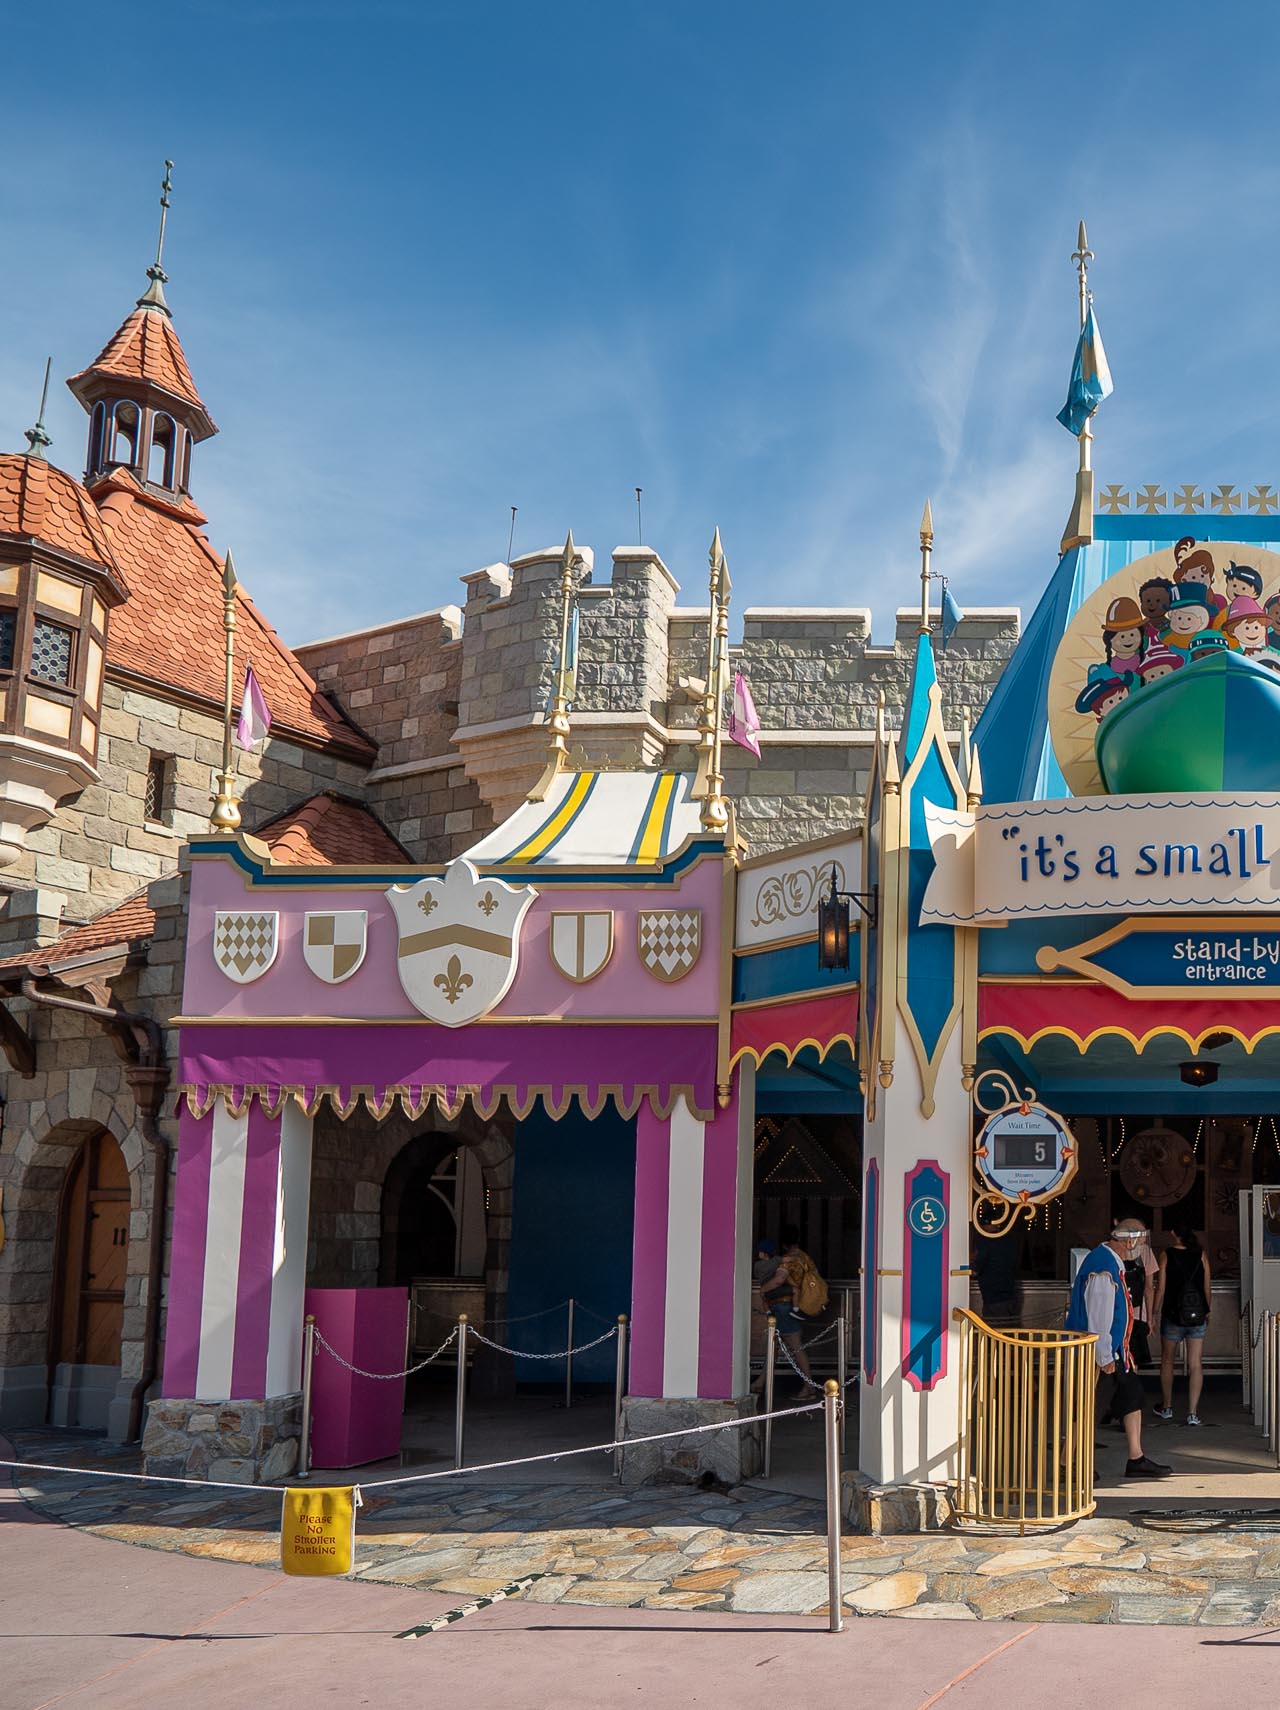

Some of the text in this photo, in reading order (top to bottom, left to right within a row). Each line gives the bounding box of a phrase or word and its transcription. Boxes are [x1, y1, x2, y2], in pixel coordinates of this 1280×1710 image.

[1094, 842, 1119, 880] a
[1134, 824, 1272, 879] small
[1172, 936, 1280, 963] stand-by
[1185, 962, 1267, 980] entrance
[1008, 1121, 1041, 1129] Wait Time
[1034, 1141, 1046, 1162] 5
[298, 1514, 333, 1524] Please
[306, 1525, 323, 1534] No
[294, 1535, 336, 1545] Stroller
[294, 1545, 336, 1555] Parking
